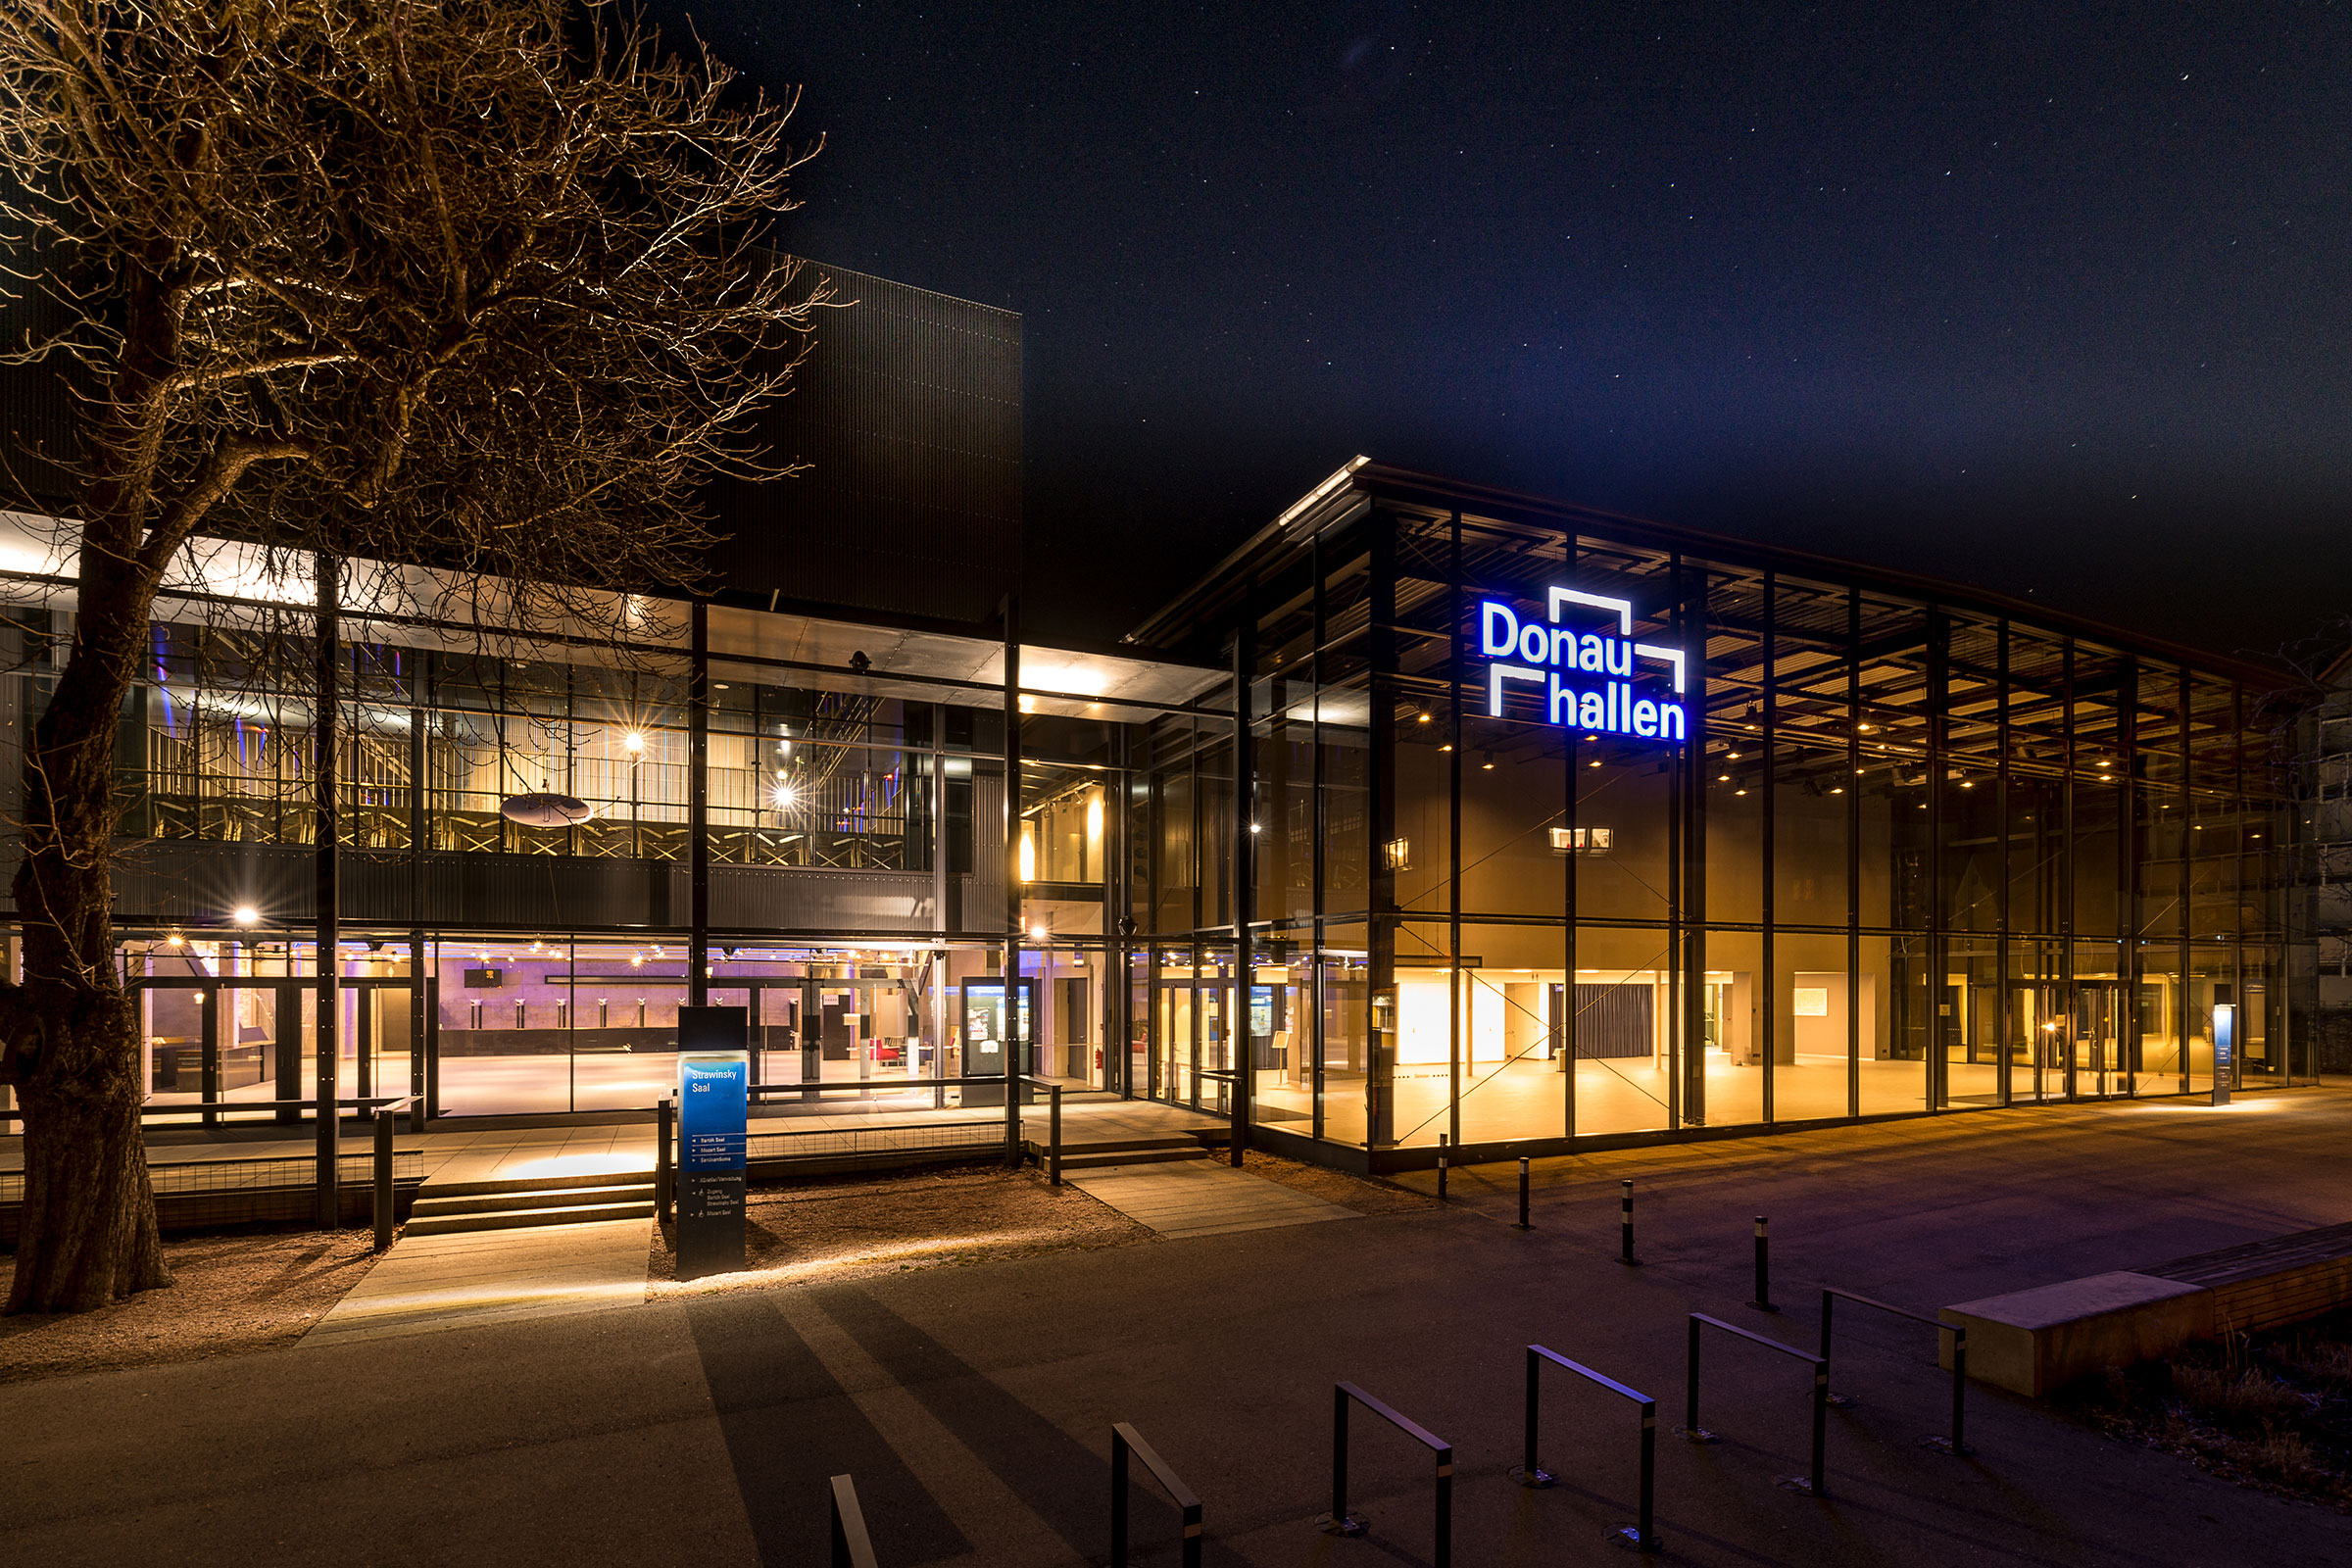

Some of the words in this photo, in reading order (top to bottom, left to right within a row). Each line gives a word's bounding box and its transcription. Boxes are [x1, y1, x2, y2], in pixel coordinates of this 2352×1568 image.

[1483, 602, 1631, 676] Donau
[1550, 672, 1685, 740] hallen
[692, 1069, 737, 1080] Strawinsky
[692, 1083, 710, 1093] Saal
